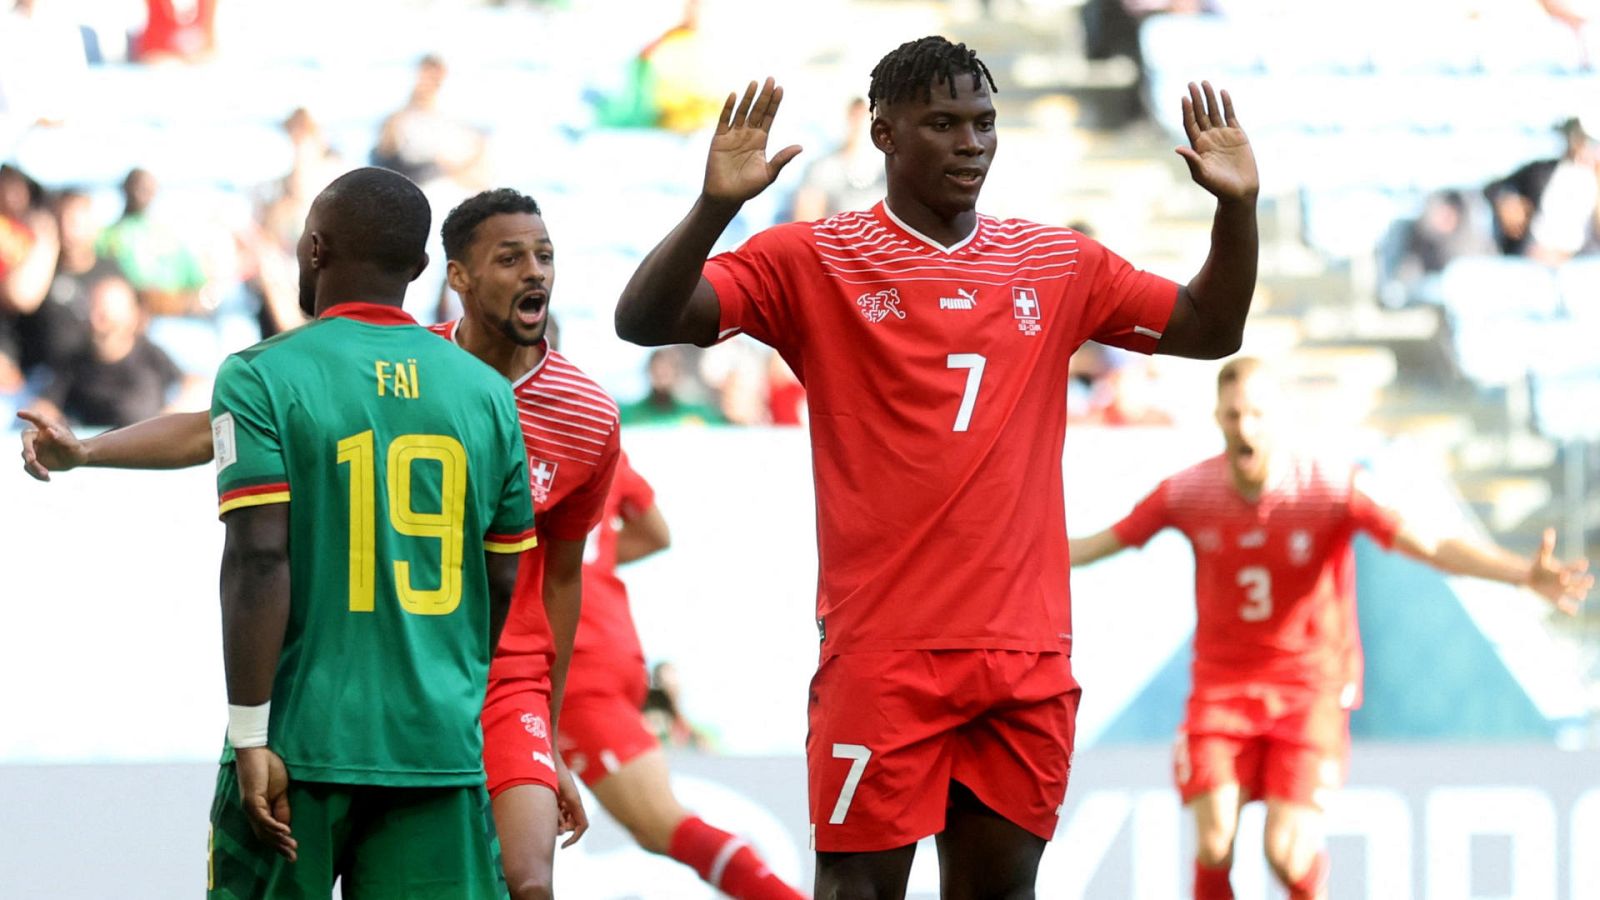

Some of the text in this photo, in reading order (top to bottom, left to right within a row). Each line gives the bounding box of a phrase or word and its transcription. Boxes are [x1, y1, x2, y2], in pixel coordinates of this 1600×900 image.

[939, 297, 972, 310] PUMA
[375, 358, 419, 399] FAÏ
[946, 353, 987, 432] 7
[336, 428, 467, 615] 19
[1237, 565, 1273, 622] 3
[829, 743, 873, 825] 7
